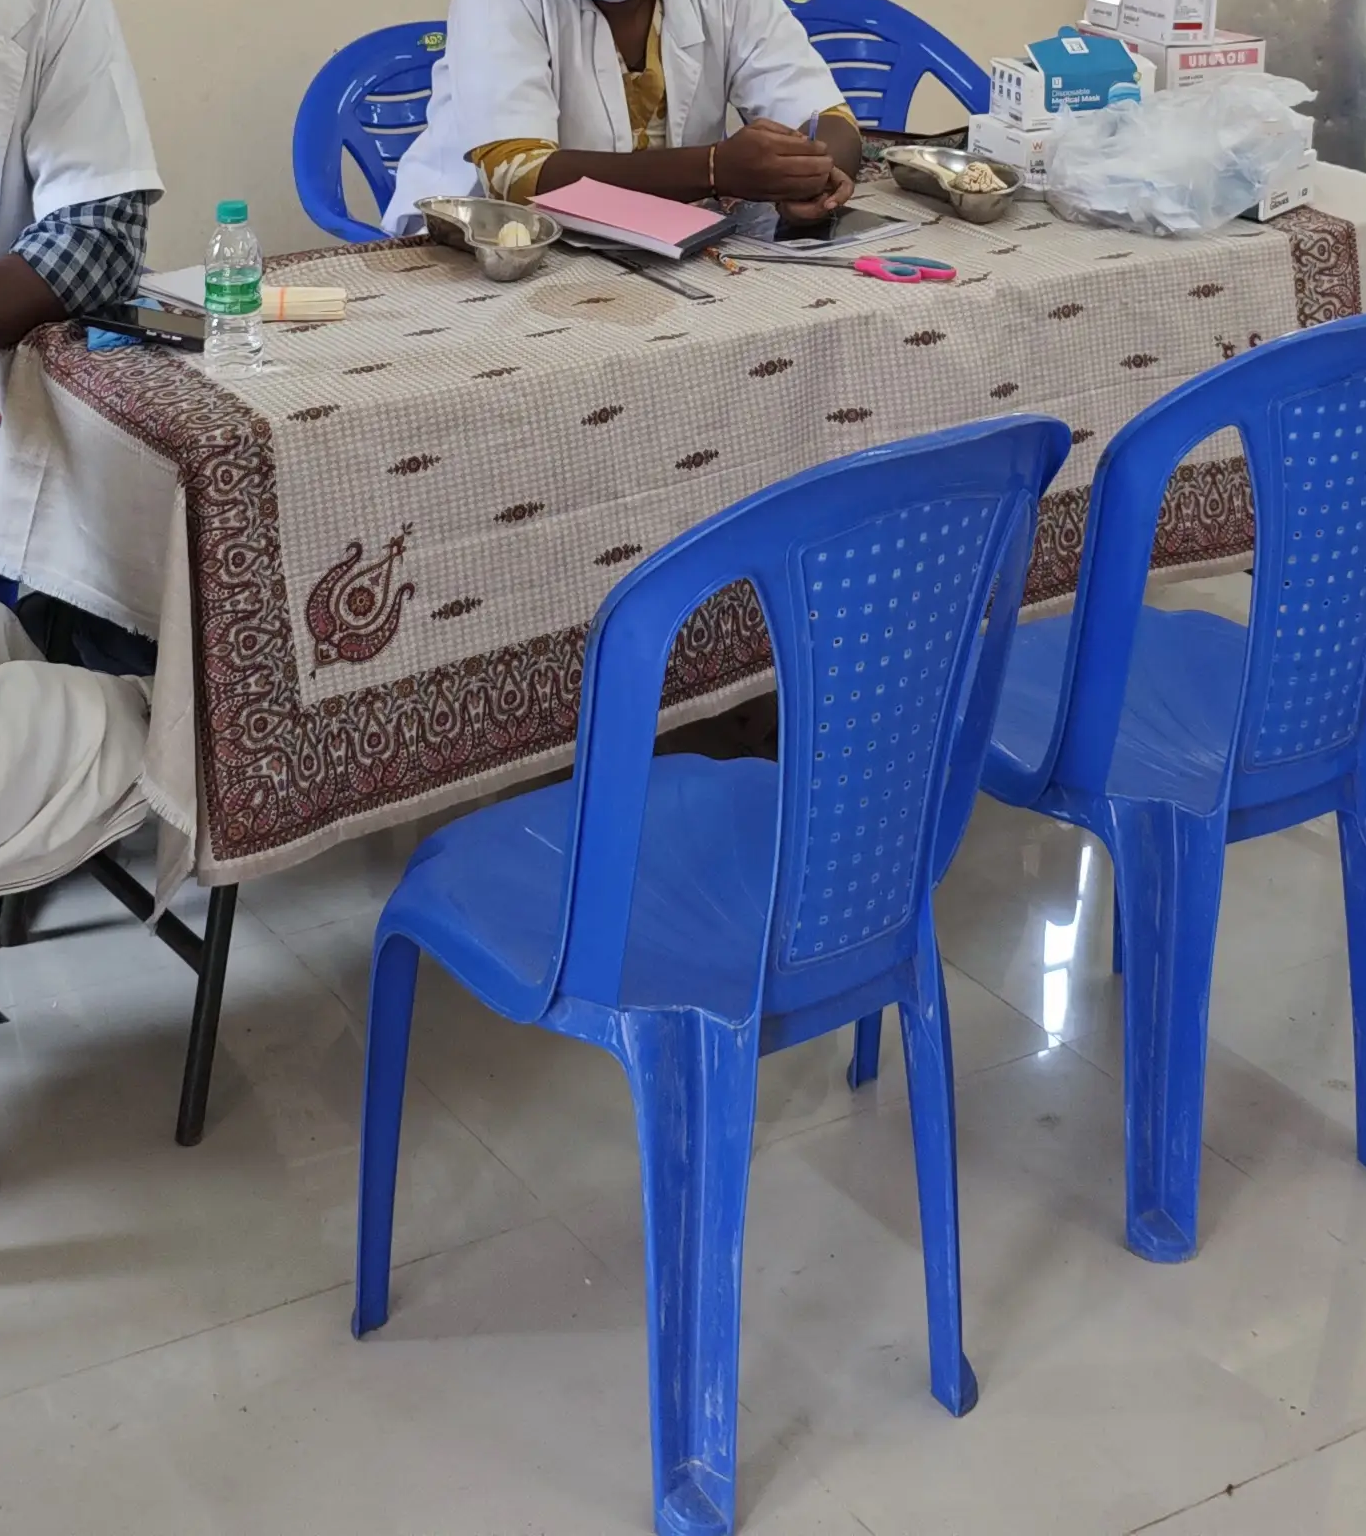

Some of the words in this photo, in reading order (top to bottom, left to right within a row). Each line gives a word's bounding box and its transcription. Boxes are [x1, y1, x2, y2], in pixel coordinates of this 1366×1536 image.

[1051, 88, 1091, 97] Disposable
[1051, 95, 1080, 104] Medical
[1081, 94, 1101, 103] Mask
